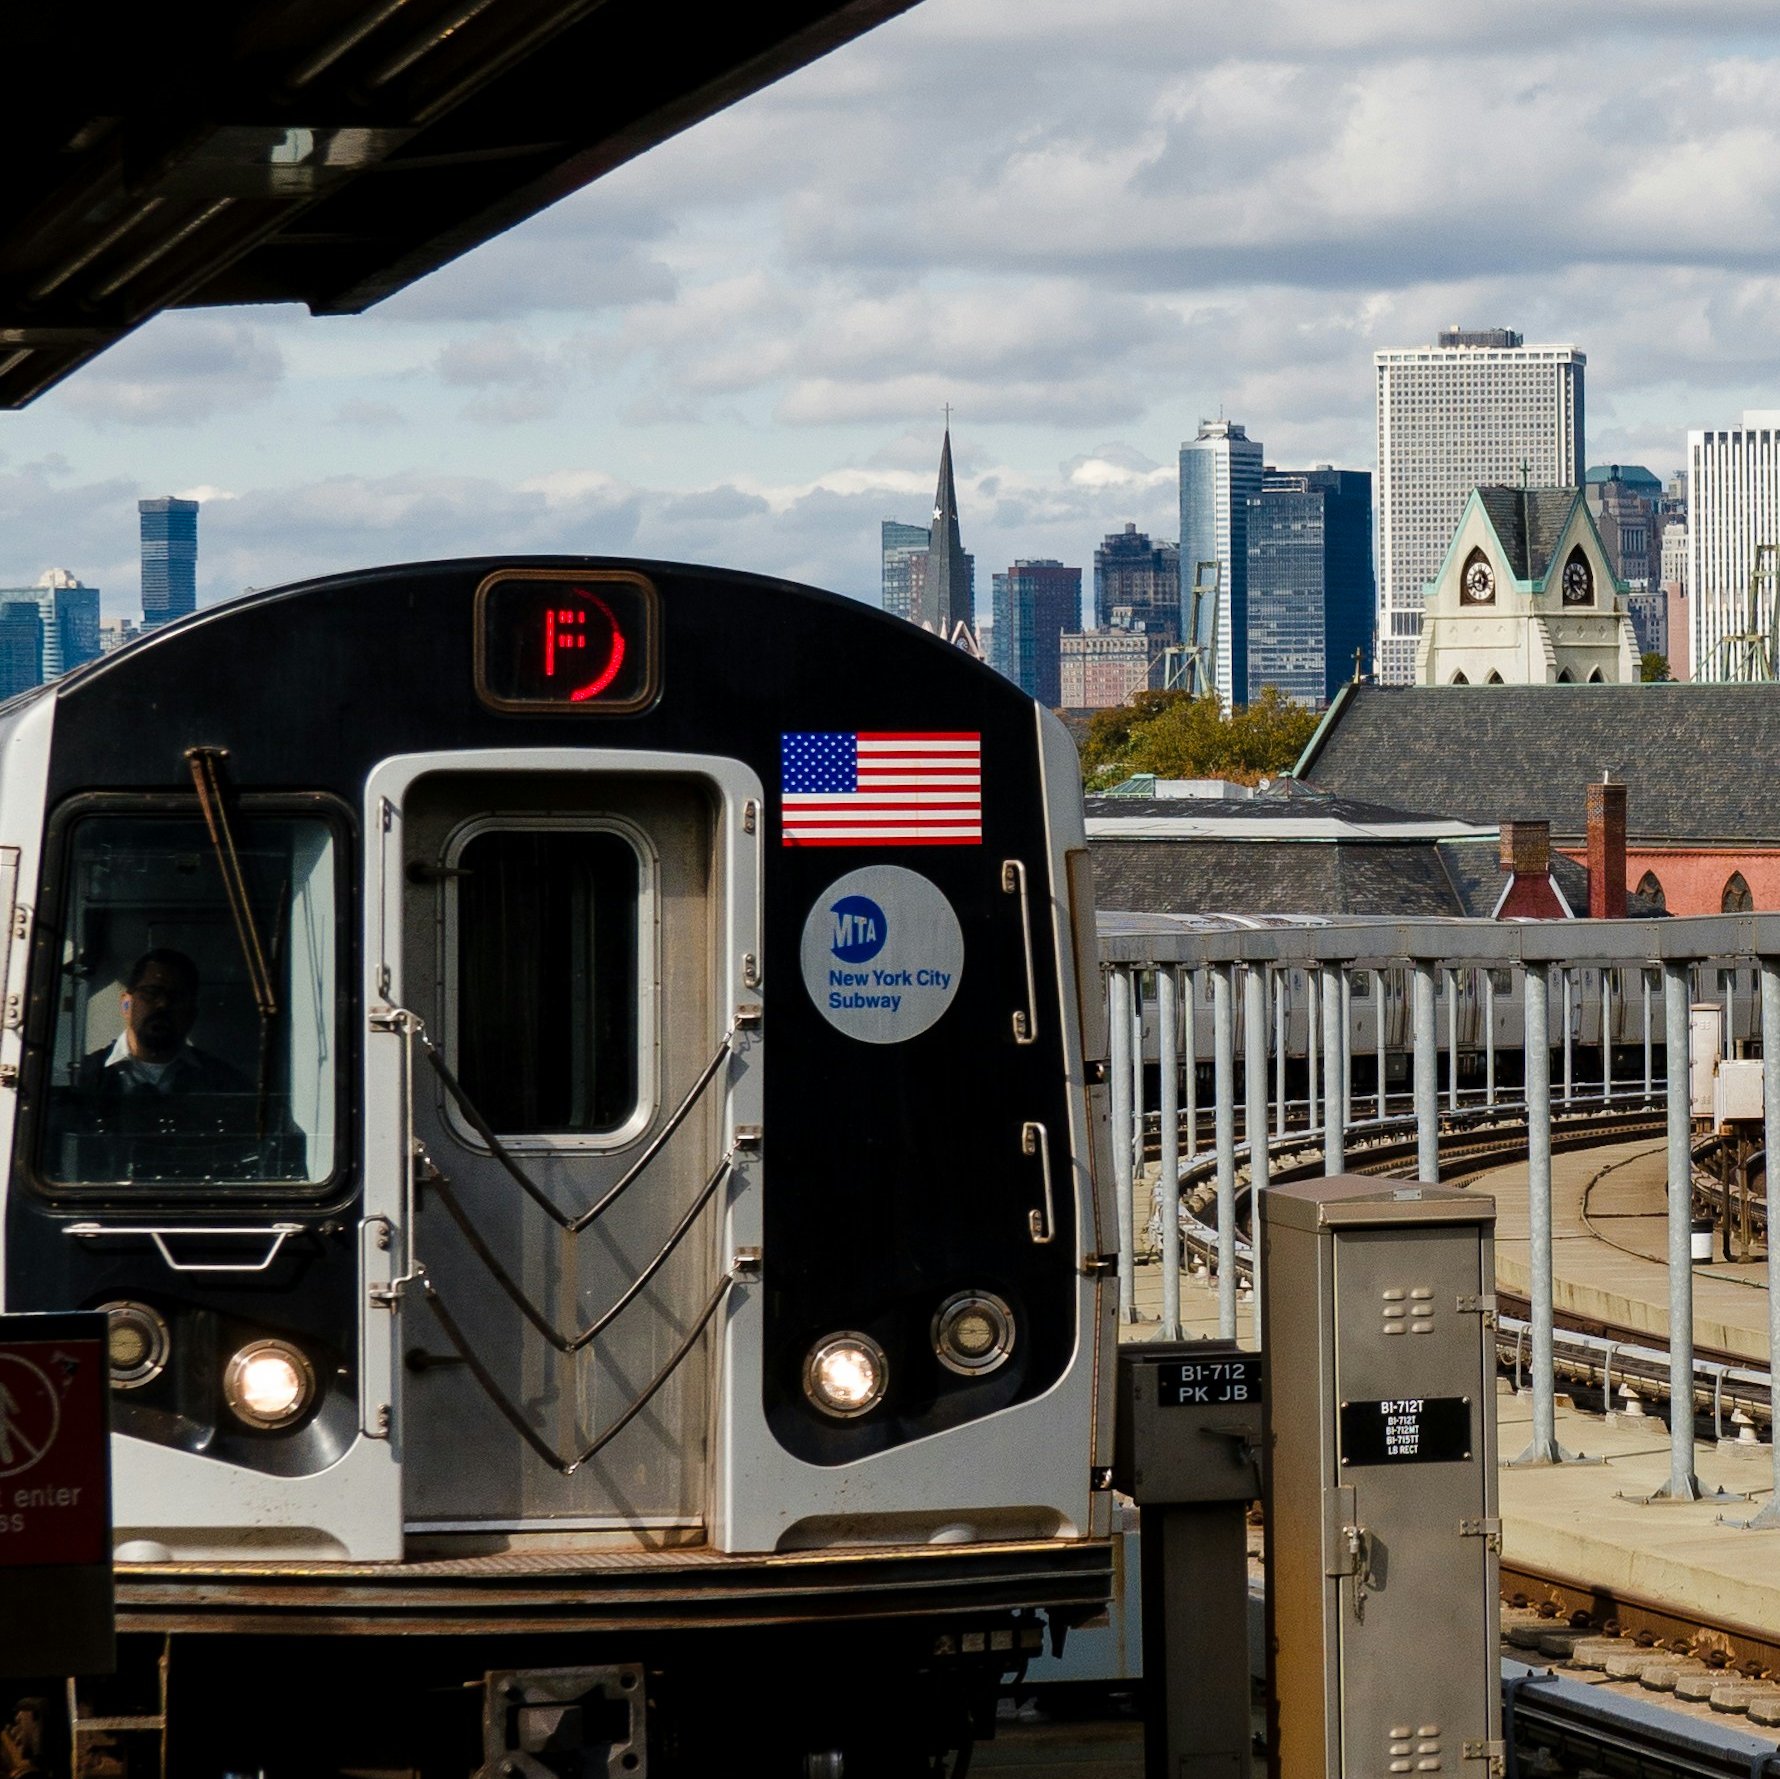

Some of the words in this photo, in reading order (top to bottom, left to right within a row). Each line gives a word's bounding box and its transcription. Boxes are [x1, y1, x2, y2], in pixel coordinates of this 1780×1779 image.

[546, 609, 586, 676] F
[830, 911, 877, 950] MTA
[829, 970, 868, 987] New
[872, 970, 912, 986] York
[916, 970, 952, 989] City
[829, 992, 902, 1012] Subway
[1179, 1386, 1209, 1402] PK
[1218, 1385, 1248, 1401] JB
[13, 1483, 82, 1508] enter
